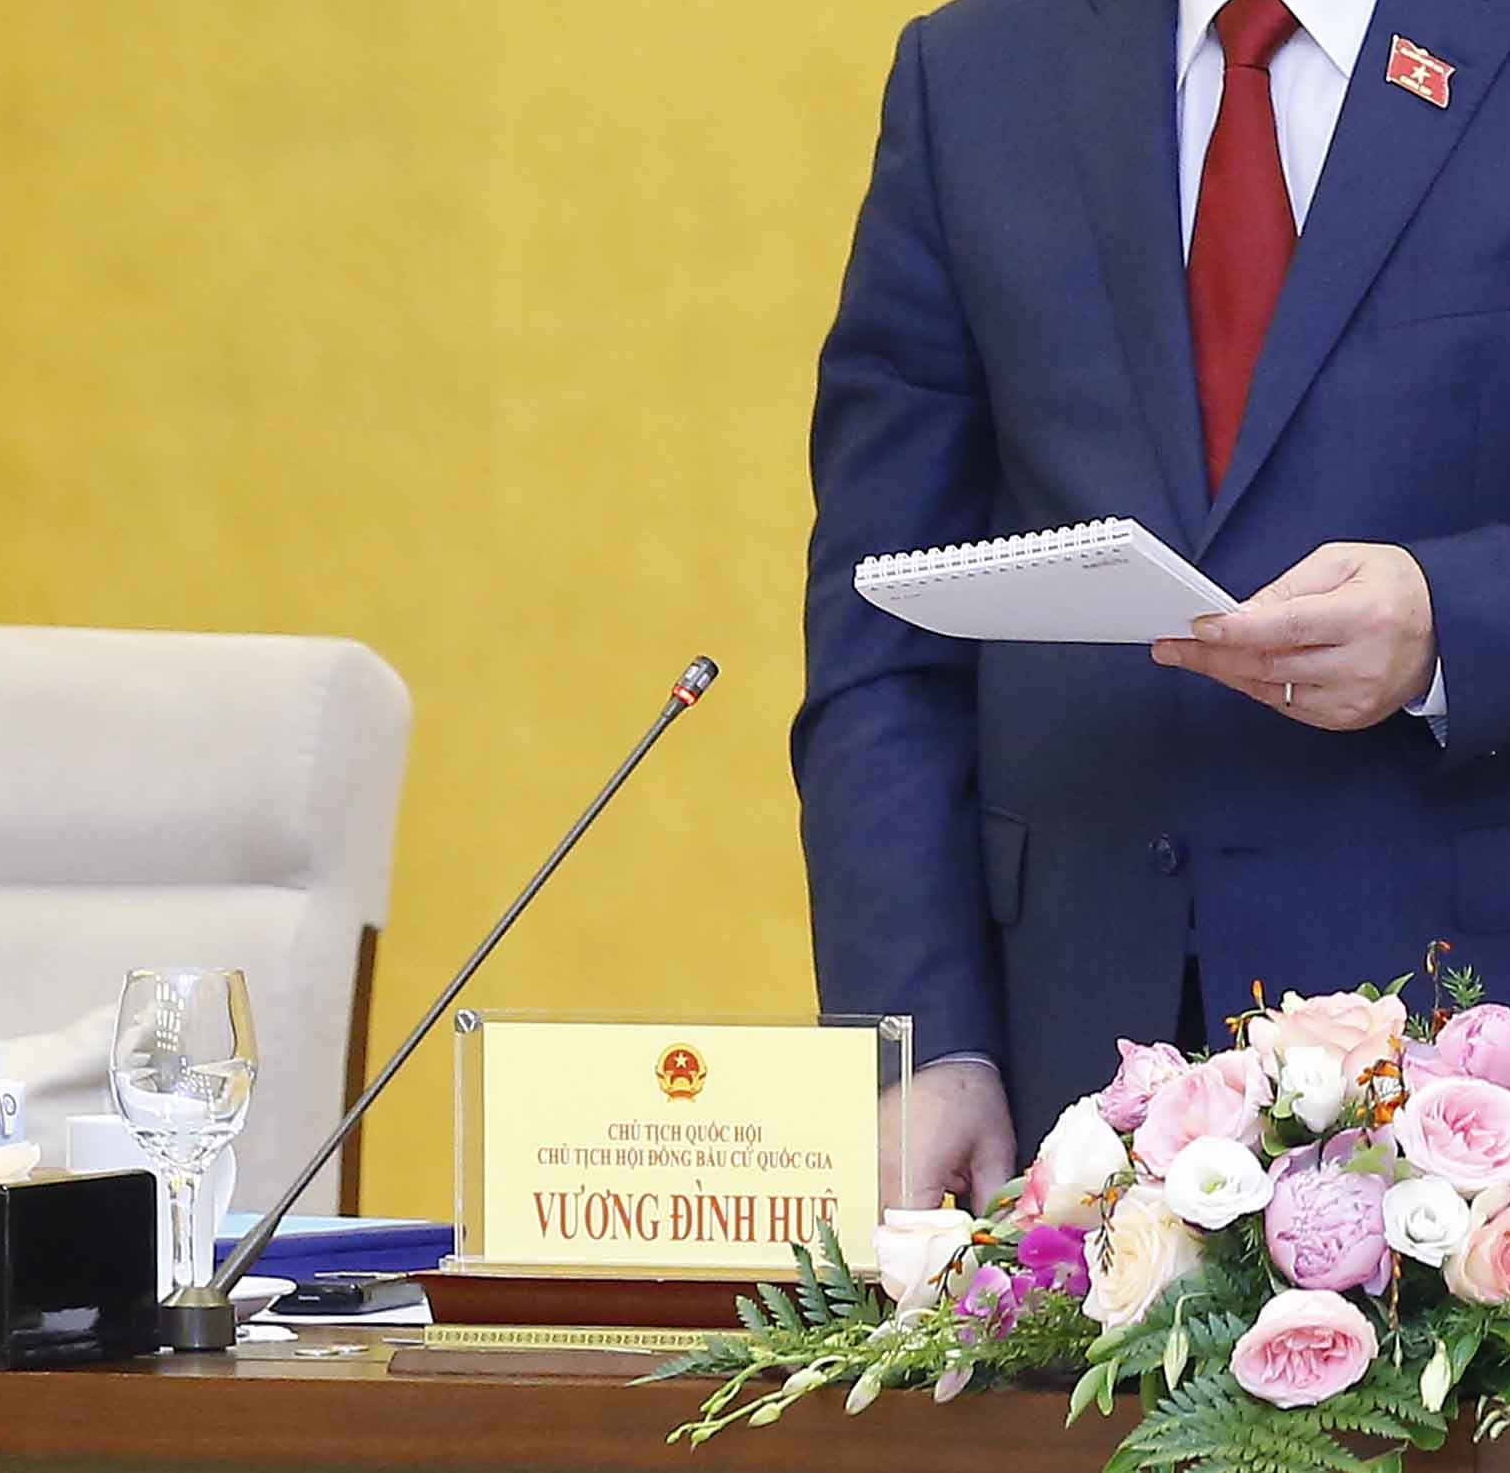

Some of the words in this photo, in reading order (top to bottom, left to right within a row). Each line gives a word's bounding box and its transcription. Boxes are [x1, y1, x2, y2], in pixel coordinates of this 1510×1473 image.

[608, 1119, 641, 1141] CHỦ
[644, 1124, 682, 1144] TỊCH
[685, 1121, 730, 1145] QUỐC
[734, 1124, 762, 1146] HỘI
[537, 1143, 570, 1165] CHỦ
[573, 1148, 612, 1169] TỊCH
[616, 1147, 644, 1169] HỘI
[648, 1144, 692, 1167] ĐỒNG
[695, 1146, 727, 1168] BẦU
[730, 1147, 754, 1169] CỬ
[757, 1147, 802, 1172] QUỐC
[805, 1152, 833, 1169] GIA
[533, 1183, 661, 1241] VƯƠNG
[669, 1179, 756, 1242] ĐÌNH
